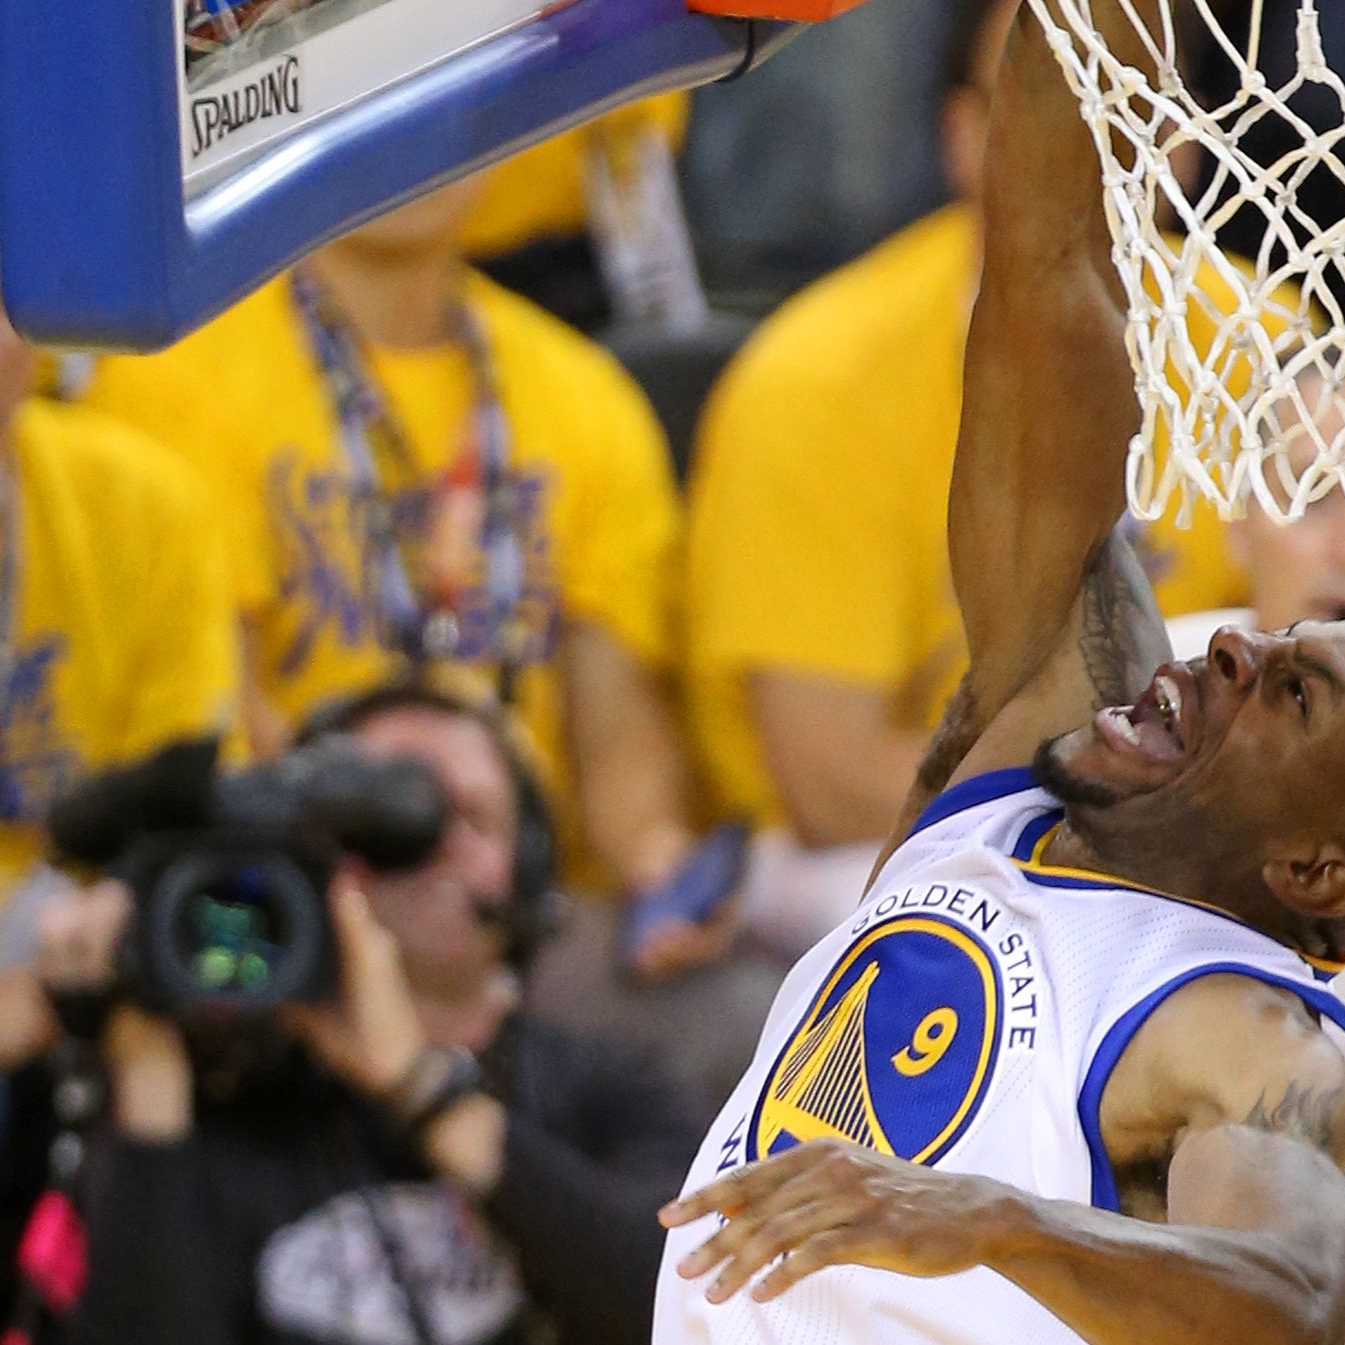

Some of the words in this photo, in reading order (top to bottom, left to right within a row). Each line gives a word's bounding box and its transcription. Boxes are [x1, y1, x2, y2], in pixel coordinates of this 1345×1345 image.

[191, 55, 302, 157] SPALDING
[851, 884, 1001, 936] GOLDEN
[999, 932, 1037, 1051] STATE
[890, 1006, 959, 1077] 9
